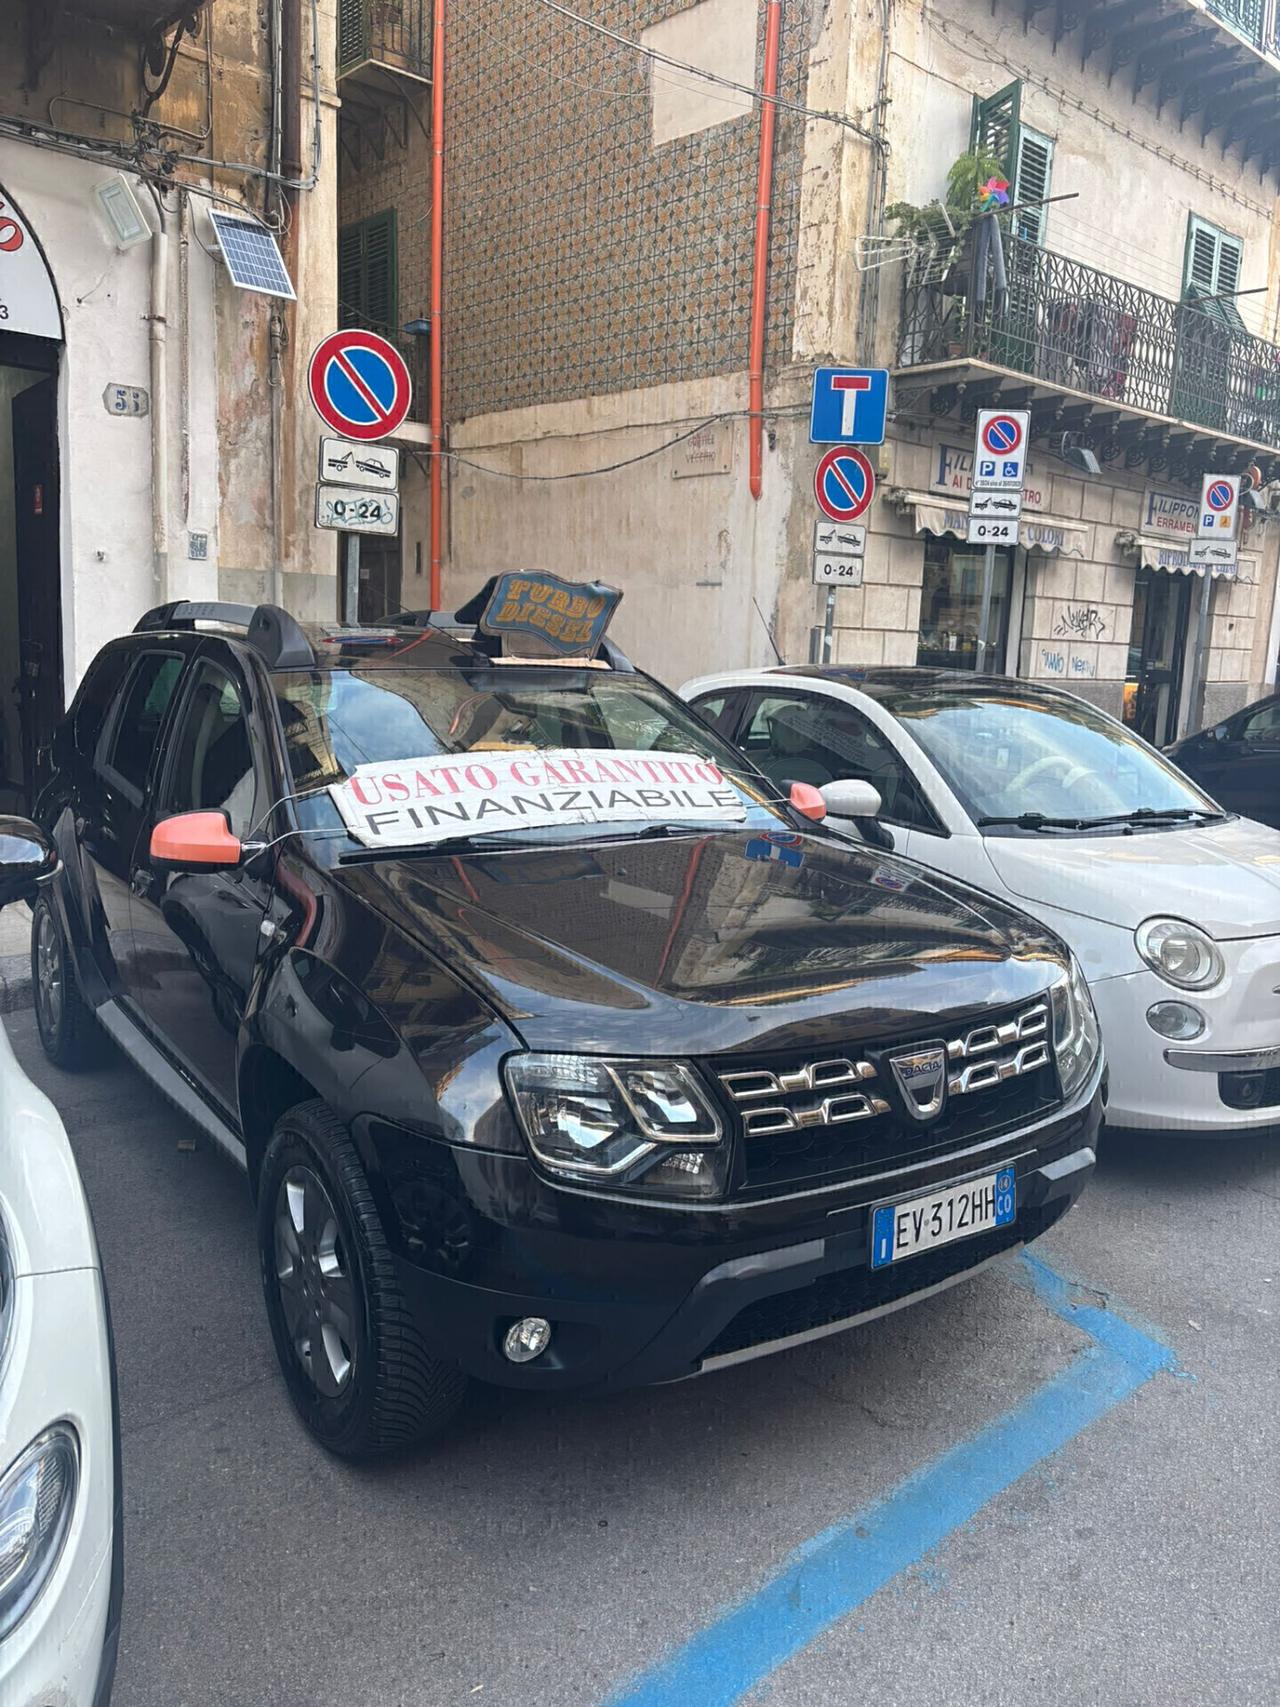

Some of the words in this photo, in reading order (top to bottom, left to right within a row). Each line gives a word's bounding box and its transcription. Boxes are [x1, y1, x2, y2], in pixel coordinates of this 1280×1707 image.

[1023, 489, 1041, 505] TRO
[334, 500, 382, 520] 0-24
[977, 526, 1009, 537] 0-24
[1027, 526, 1065, 547] COLORI
[824, 564, 853, 577] 0-24
[506, 579, 606, 618] TURBO
[496, 601, 593, 642] DIESEL
[350, 763, 498, 807] USATO
[510, 759, 724, 788] GARANTITO
[365, 789, 744, 836] FINANZIABILE
[901, 1061, 941, 1079] DACIA
